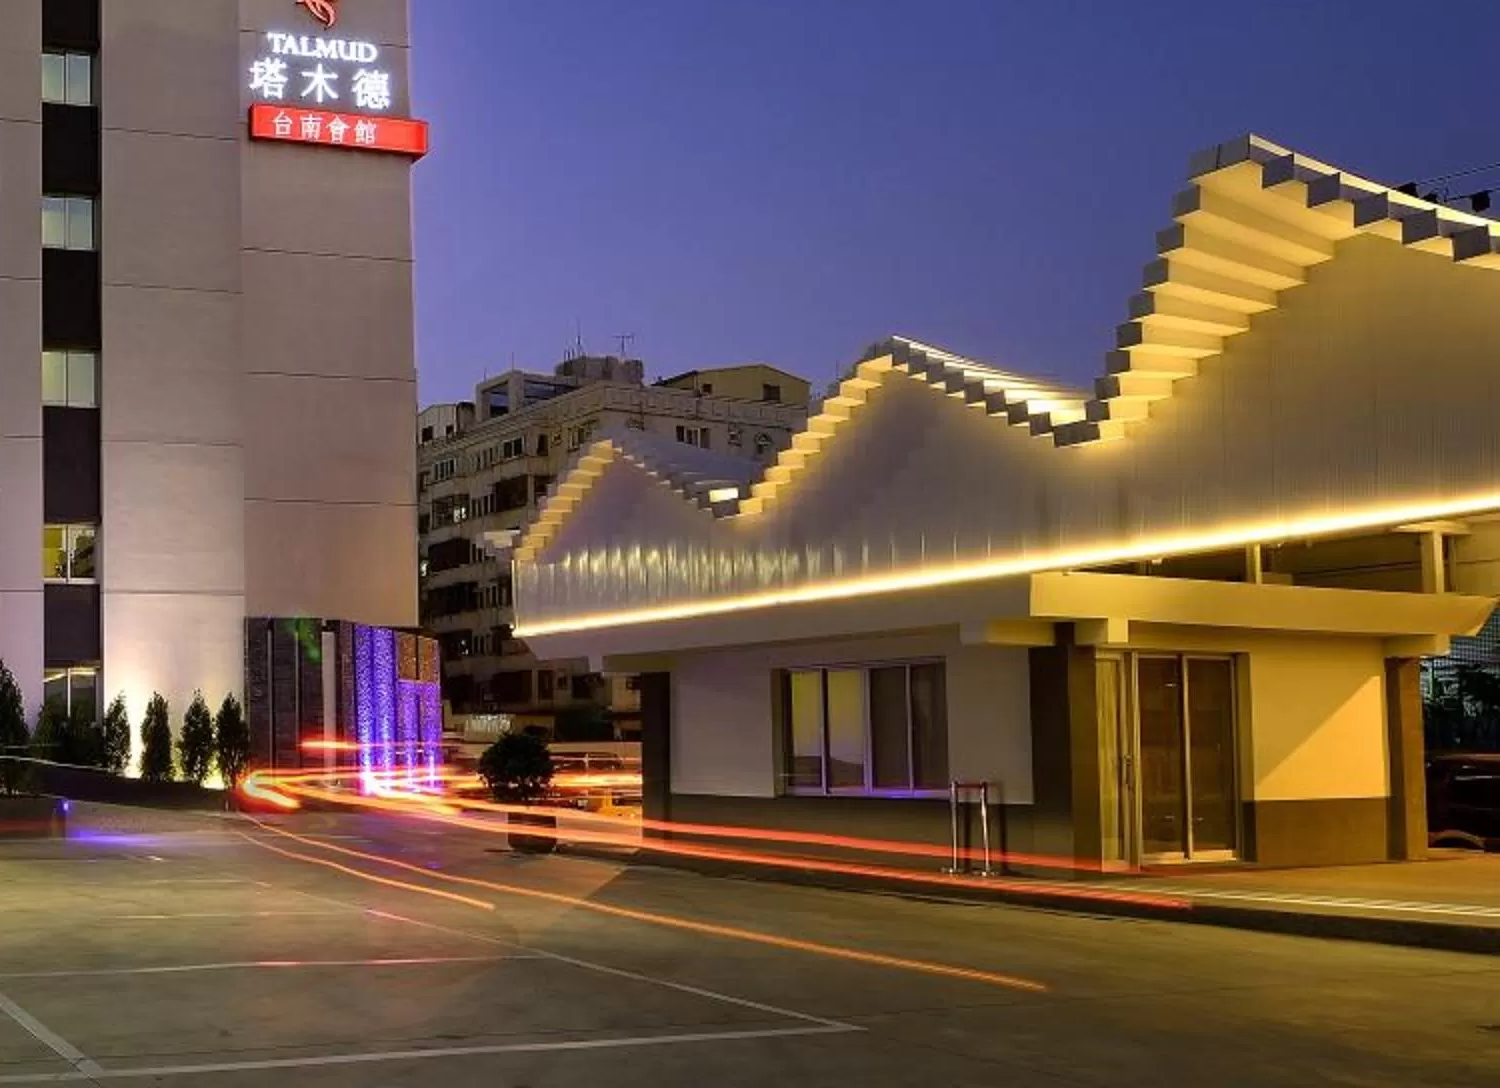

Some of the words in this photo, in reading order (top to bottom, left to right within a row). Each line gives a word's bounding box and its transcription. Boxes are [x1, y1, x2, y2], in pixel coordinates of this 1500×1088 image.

[267, 32, 378, 63] TALMUD
[250, 57, 391, 109] 塔木德
[272, 111, 377, 144] 台南會館
